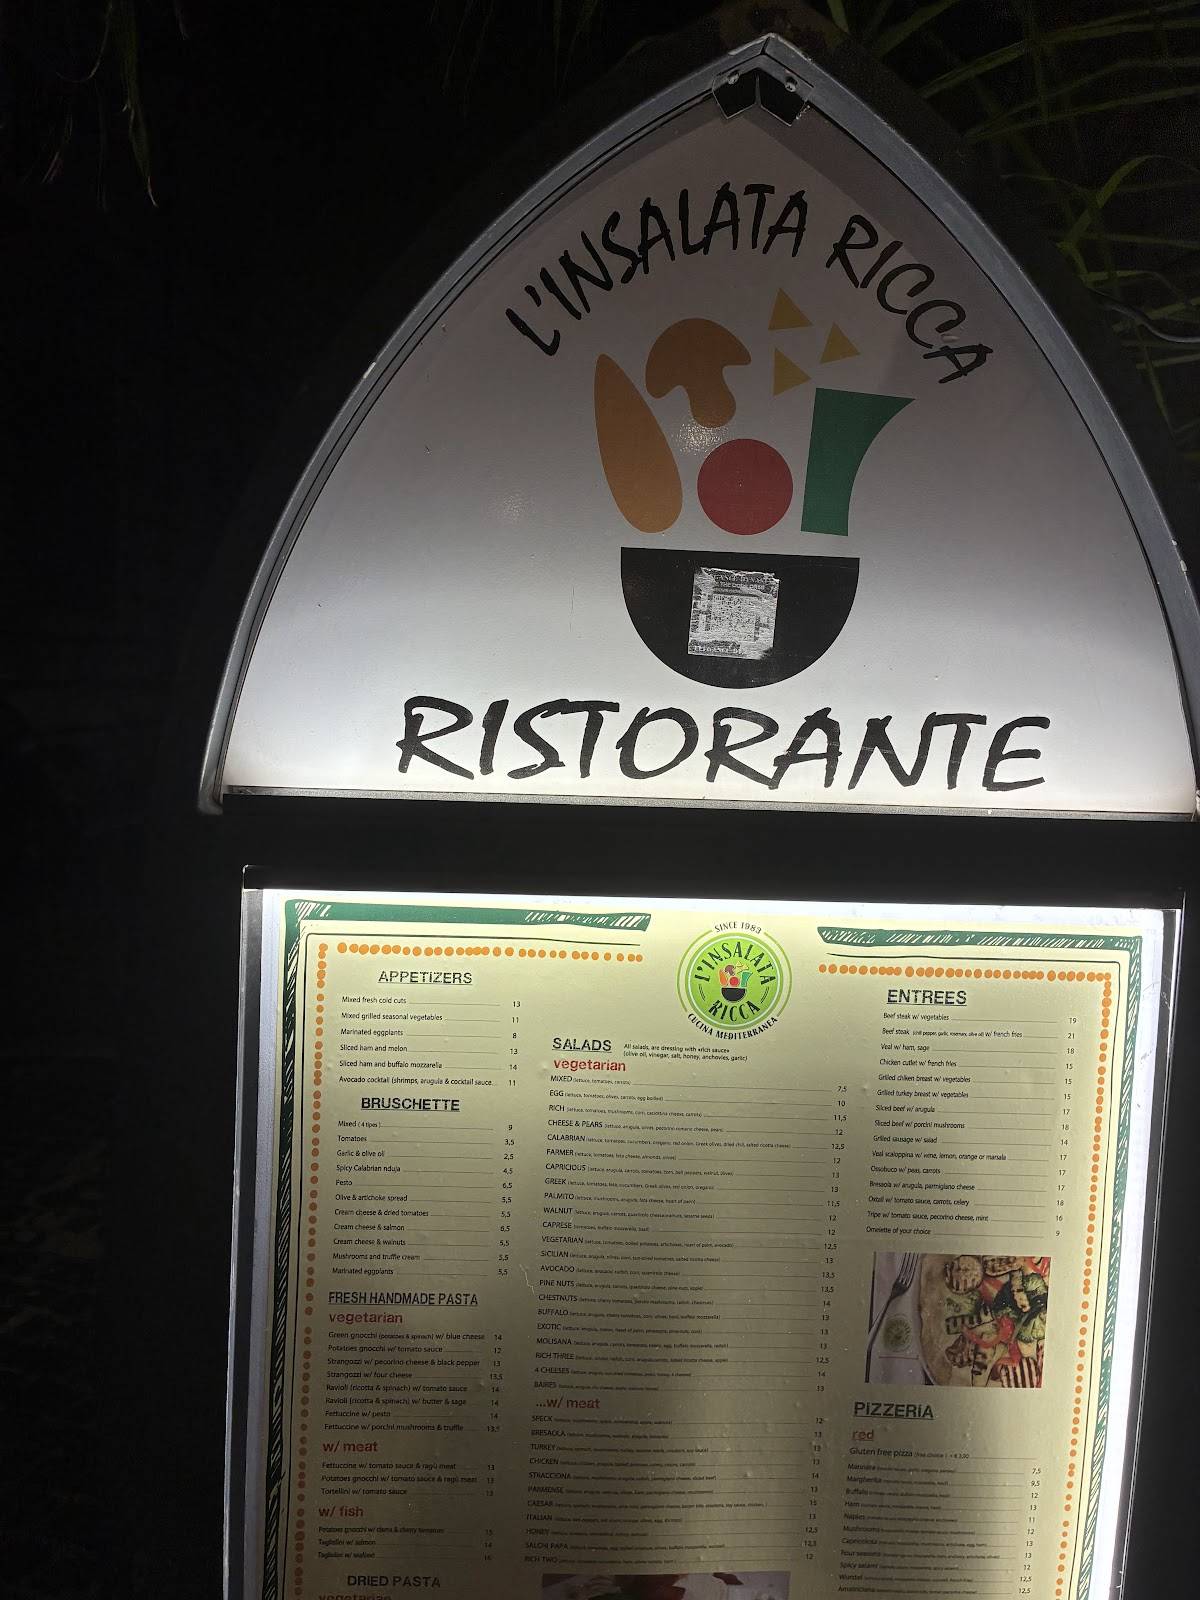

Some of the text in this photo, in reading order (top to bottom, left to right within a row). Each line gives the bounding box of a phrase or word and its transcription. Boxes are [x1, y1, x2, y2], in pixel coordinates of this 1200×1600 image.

[505, 183, 994, 383] L'INSALATA RICCA
[396, 694, 1050, 791] RISTORANTE
[715, 921, 761, 933] SINCE 1983
[695, 941, 776, 985] L'INSALATA
[887, 989, 967, 1004] ENTREES
[709, 1000, 760, 1021] RICCA
[410, 1014, 442, 1022] vegetables
[688, 1013, 778, 1040] CUCINA MEDITERRANEA
[553, 1038, 611, 1051] SALADS
[554, 1060, 625, 1071] vegetarian
[392, 1077, 419, 1085] (shrimps,
[943, 1076, 970, 1084] vegetables
[362, 1098, 460, 1110] BRUSCHETTE
[337, 1165, 352, 1173] Spicy
[329, 1292, 478, 1305] FRESH HANDMADE PASTA
[329, 1312, 403, 1324] vegetarian
[567, 1400, 600, 1408] meat
[852, 1430, 874, 1440] red
[323, 1441, 378, 1452] w/ meat
[894, 1450, 912, 1458] pizza
[319, 1506, 364, 1517] w/ fish
[347, 1576, 440, 1587] DRIED PASTA
